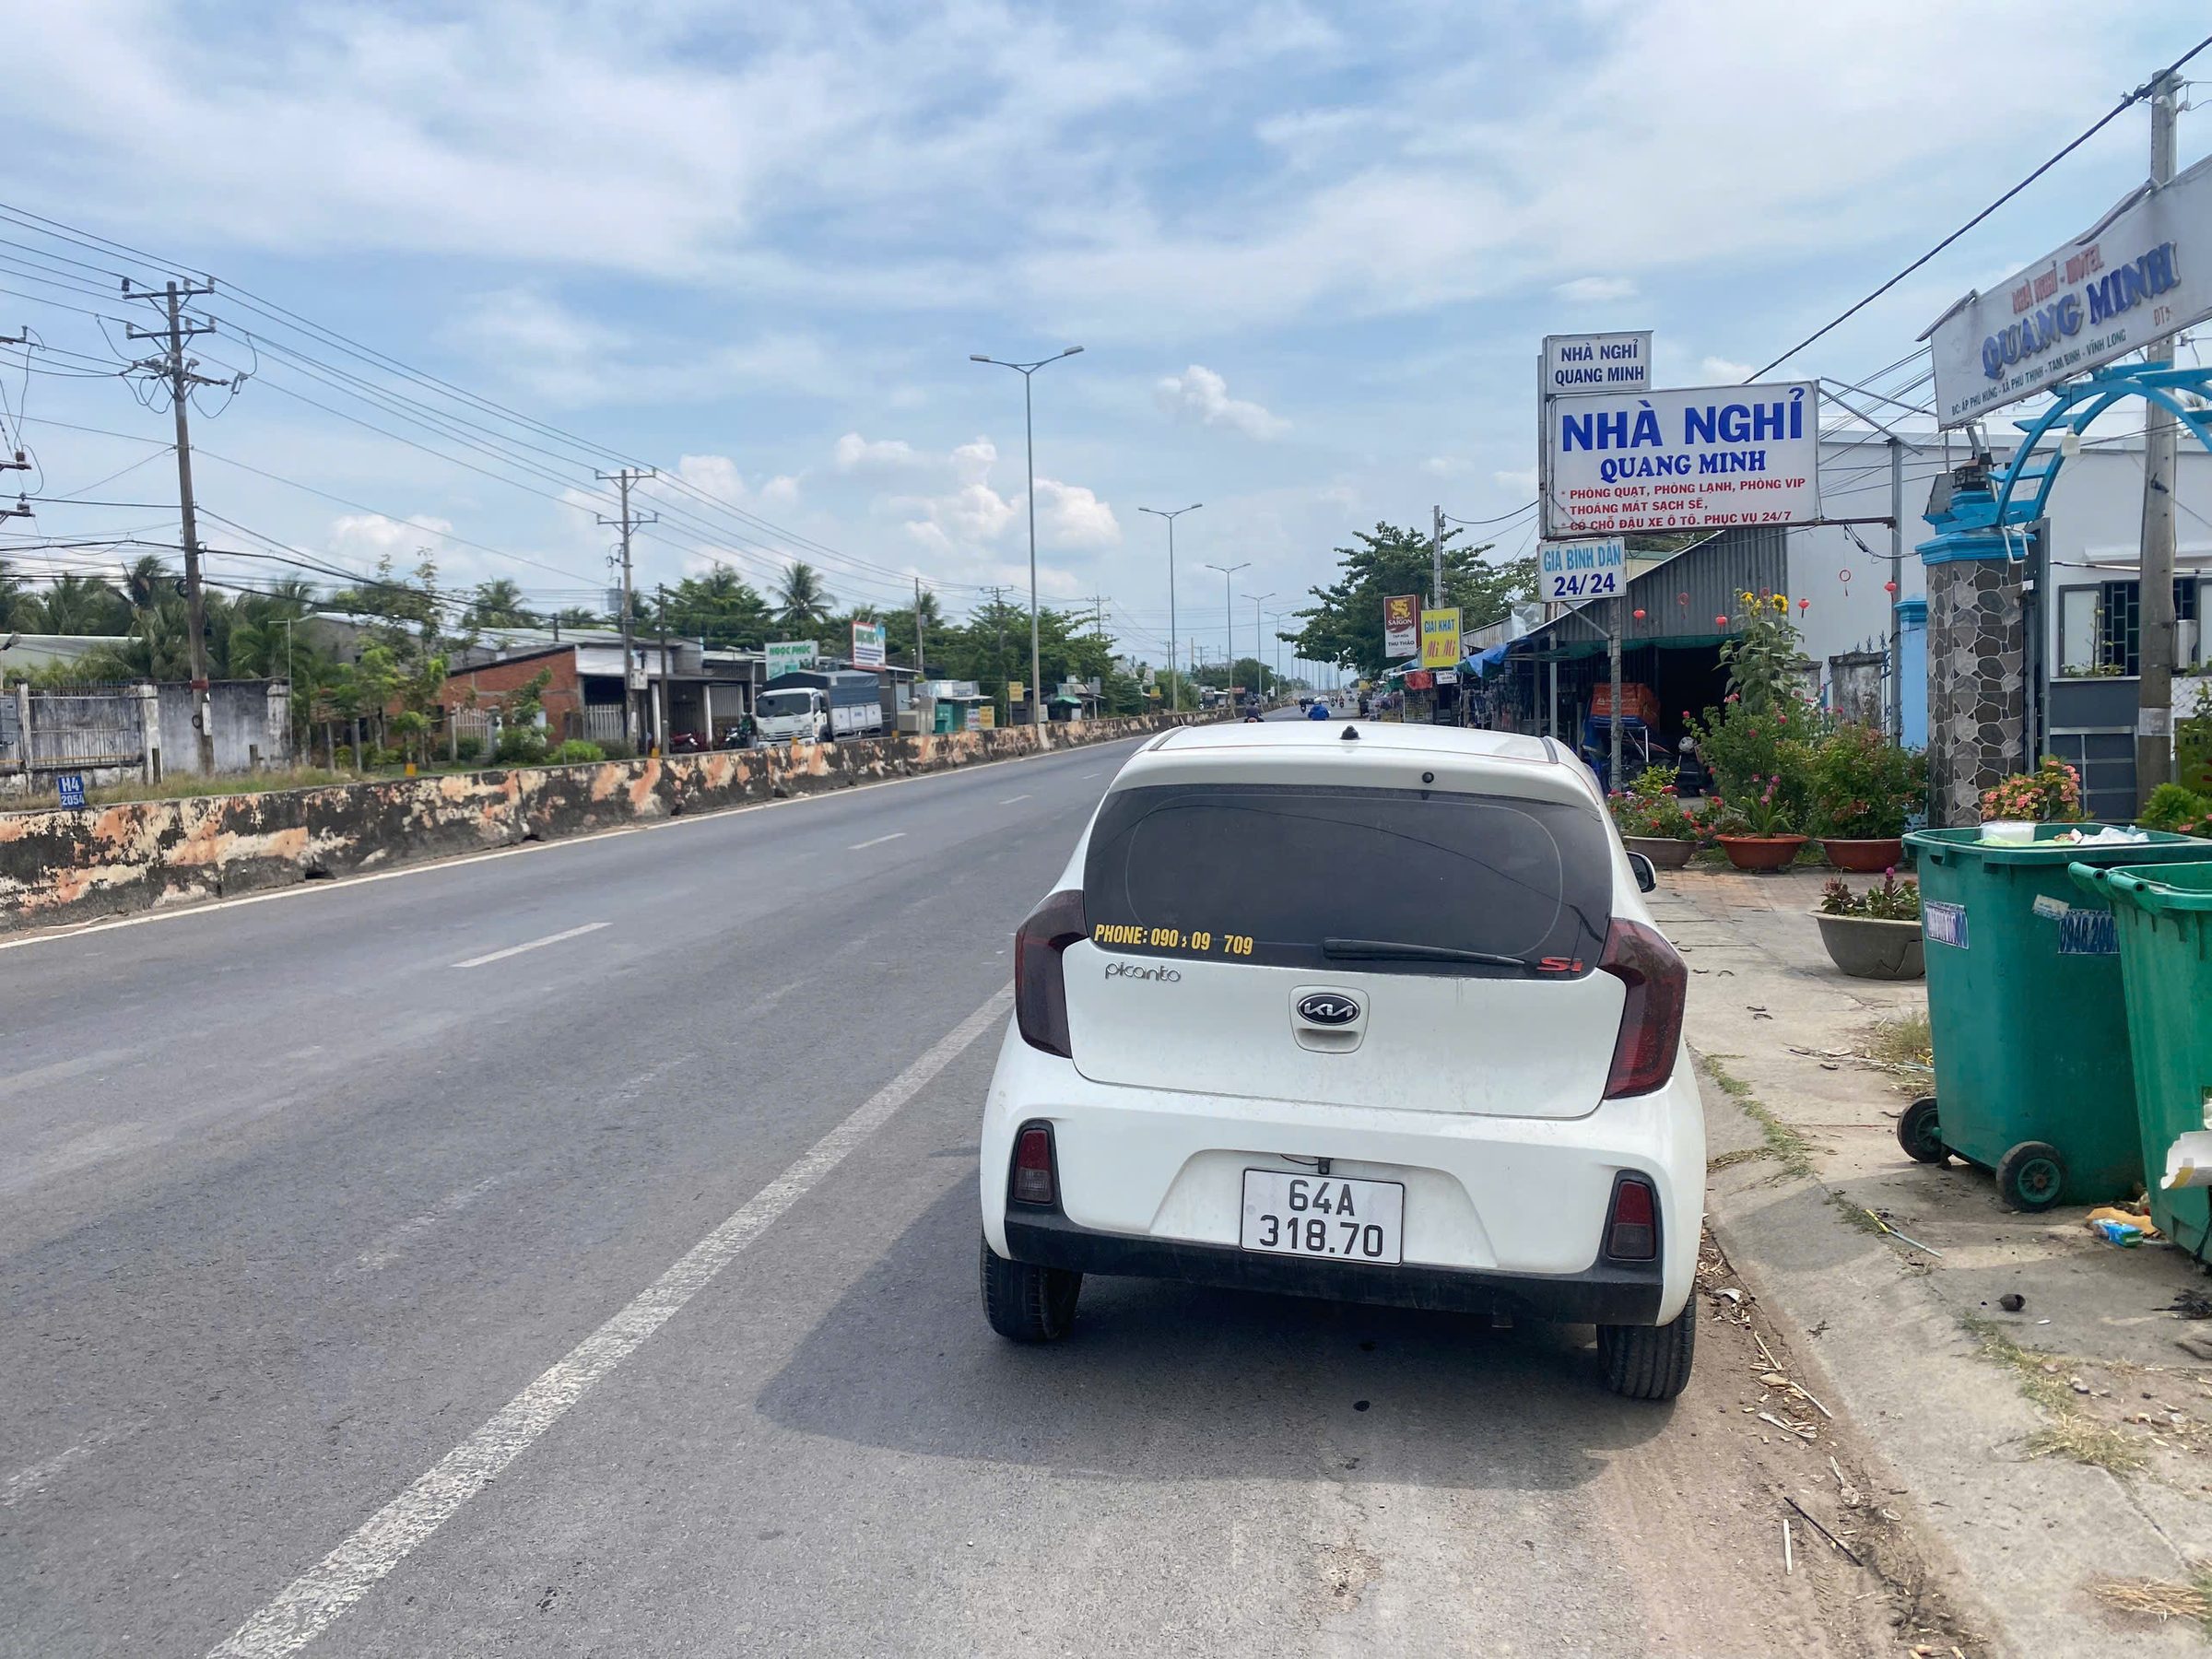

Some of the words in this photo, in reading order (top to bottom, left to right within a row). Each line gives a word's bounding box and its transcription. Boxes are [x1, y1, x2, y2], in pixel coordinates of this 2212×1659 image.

[1983, 293, 2084, 380] QUANG
[2086, 241, 2181, 325] MINH
[1561, 342, 1594, 362] NHÀ
[1600, 338, 1639, 360] NGHỈ
[2048, 357, 2064, 372] TAM
[2106, 329, 2126, 348] LONG
[1555, 368, 1603, 386] QUANG
[1607, 366, 1644, 382] MINH
[1562, 399, 1663, 453] NHÀ
[1684, 387, 1806, 445] NGHỈ
[1600, 454, 1692, 483] QUANG
[1699, 450, 1766, 475] MINH
[1570, 486, 1611, 500] PHÒNG
[1614, 486, 1650, 499] QUẠT,
[1654, 482, 1695, 495] PHÒNG
[1699, 481, 1735, 494] LẠNH,
[1740, 477, 1782, 490] PHÒNG
[1785, 477, 1806, 488] VIP
[1570, 501, 1618, 515] THOÁNG
[1621, 500, 1648, 512] MÁT
[1652, 500, 1684, 513] SẠCH
[1570, 518, 1586, 531] CÓ
[1619, 516, 1644, 529] ĐẬU
[1648, 517, 1664, 527] XE
[1667, 513, 1676, 526] Ô
[1704, 512, 1737, 526] PHỤC
[1741, 512, 1758, 524] VỤ
[1761, 511, 1792, 522] 24/7
[1544, 545, 1562, 572] GIÁ
[1567, 544, 1594, 571] BÌNH
[1597, 539, 1621, 567] DÂN
[1554, 572, 1616, 597] 24/24
[1387, 618, 1413, 627] SAIGON
[770, 646, 791, 657] NGỌC
[61, 777, 80, 792] H4
[61, 794, 85, 806] 2054
[1093, 924, 1148, 945] PHONE:
[1149, 927, 1179, 948] 090
[1191, 931, 1211, 951] 09
[1223, 934, 1253, 956] 709
[1105, 961, 1182, 982] picanto
[1288, 1179, 1355, 1217] 64A
[1259, 1214, 1383, 1257] 318.70
